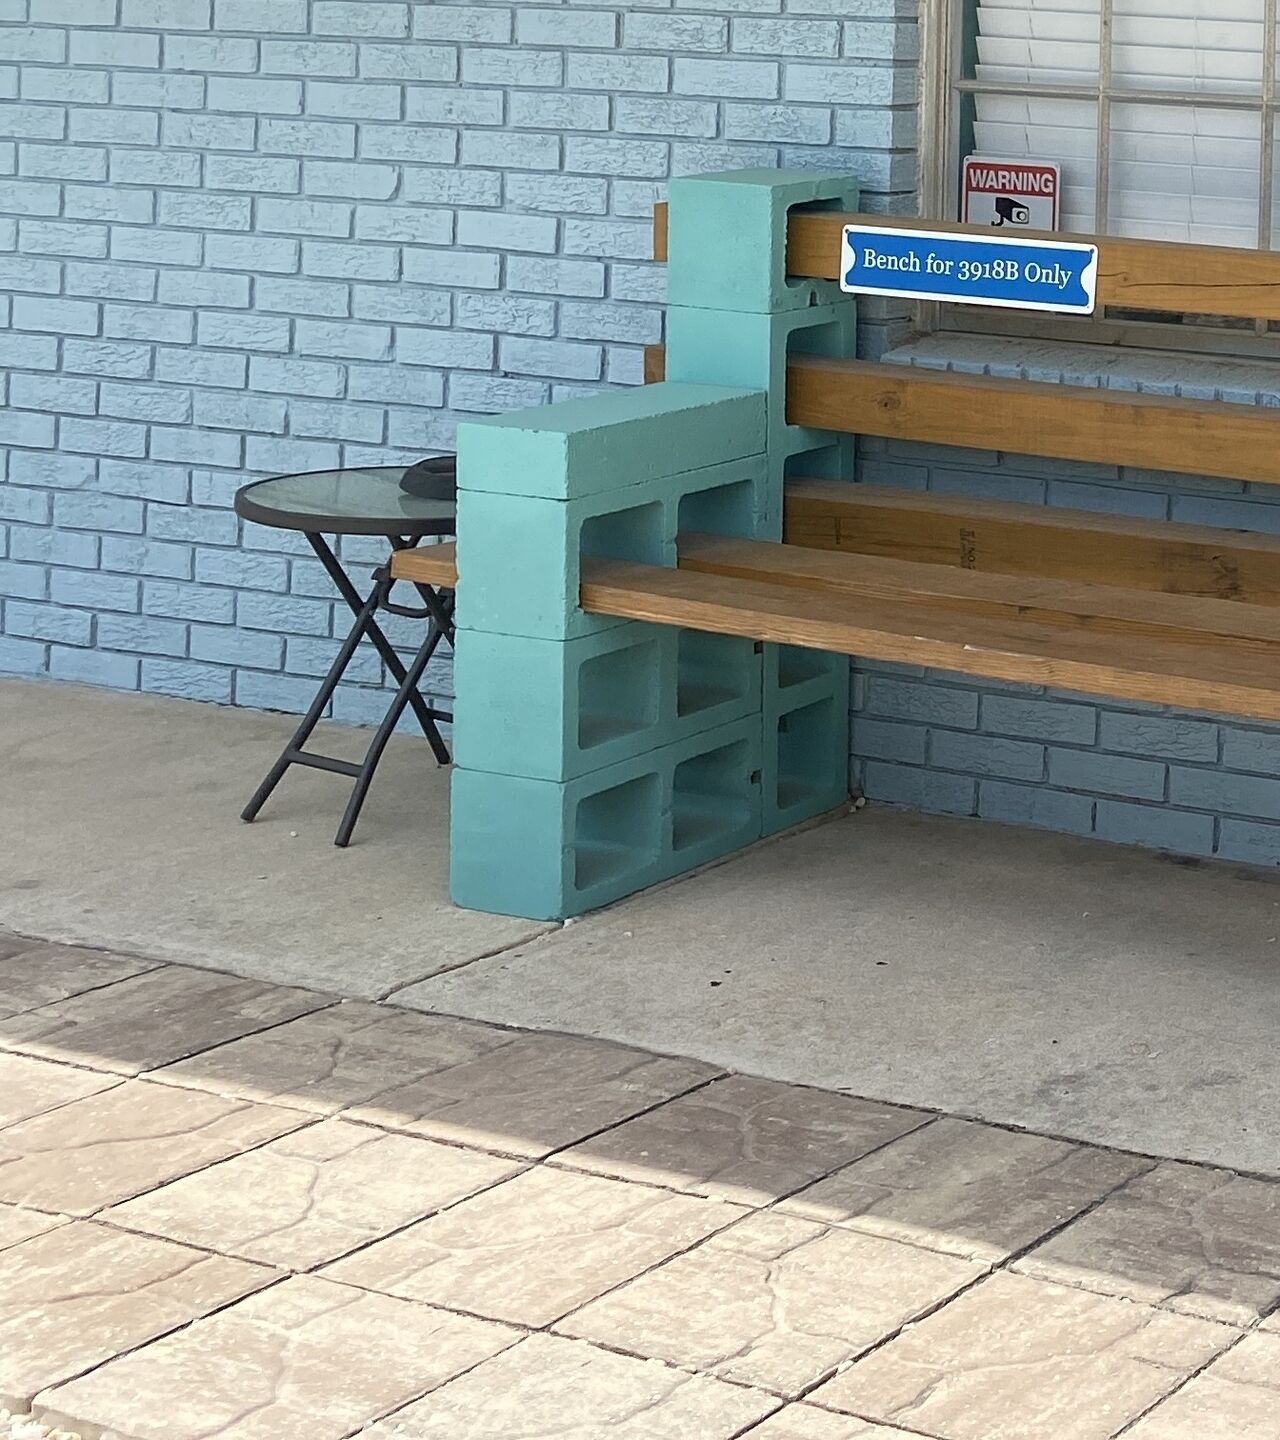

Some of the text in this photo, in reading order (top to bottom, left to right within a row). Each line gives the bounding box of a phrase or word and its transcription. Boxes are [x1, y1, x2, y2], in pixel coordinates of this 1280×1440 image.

[968, 168, 1054, 193] WARNING
[863, 248, 1073, 289] Bench for 3918B Only
